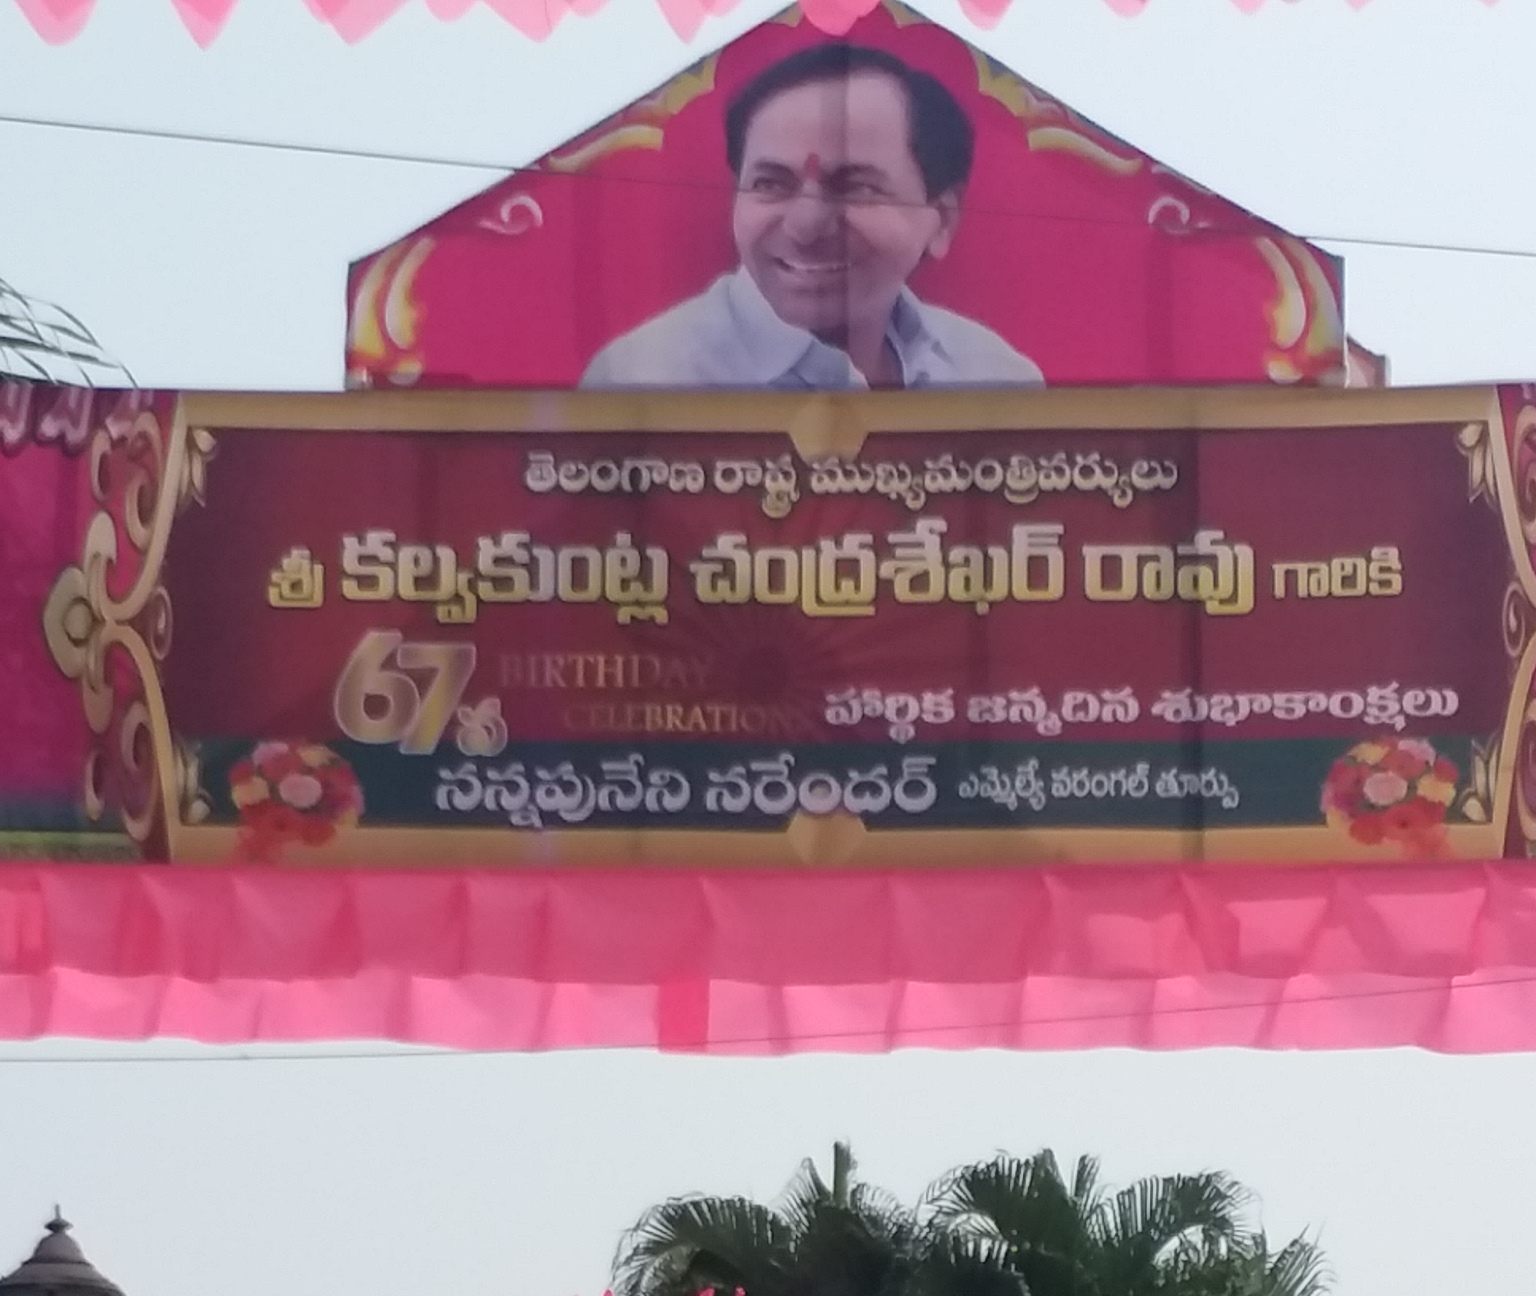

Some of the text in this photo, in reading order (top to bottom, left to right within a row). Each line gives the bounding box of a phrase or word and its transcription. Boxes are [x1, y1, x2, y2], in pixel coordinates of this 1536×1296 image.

[523, 451, 705, 494] తెలంగాణ
[339, 528, 669, 624] కల్వకుంట్ల
[688, 517, 1065, 617] చంద్రశేఖర్
[1081, 528, 1255, 615] రావు
[1271, 545, 1403, 599] గారికి
[498, 651, 714, 689] BIRTHDAY
[966, 685, 1141, 737] జన్మదిన
[1150, 680, 1459, 733] శుభాకాంక్షలు
[435, 752, 937, 828] నన్నపునేని నరేందర్
[1050, 760, 1151, 799] వరంగల్
